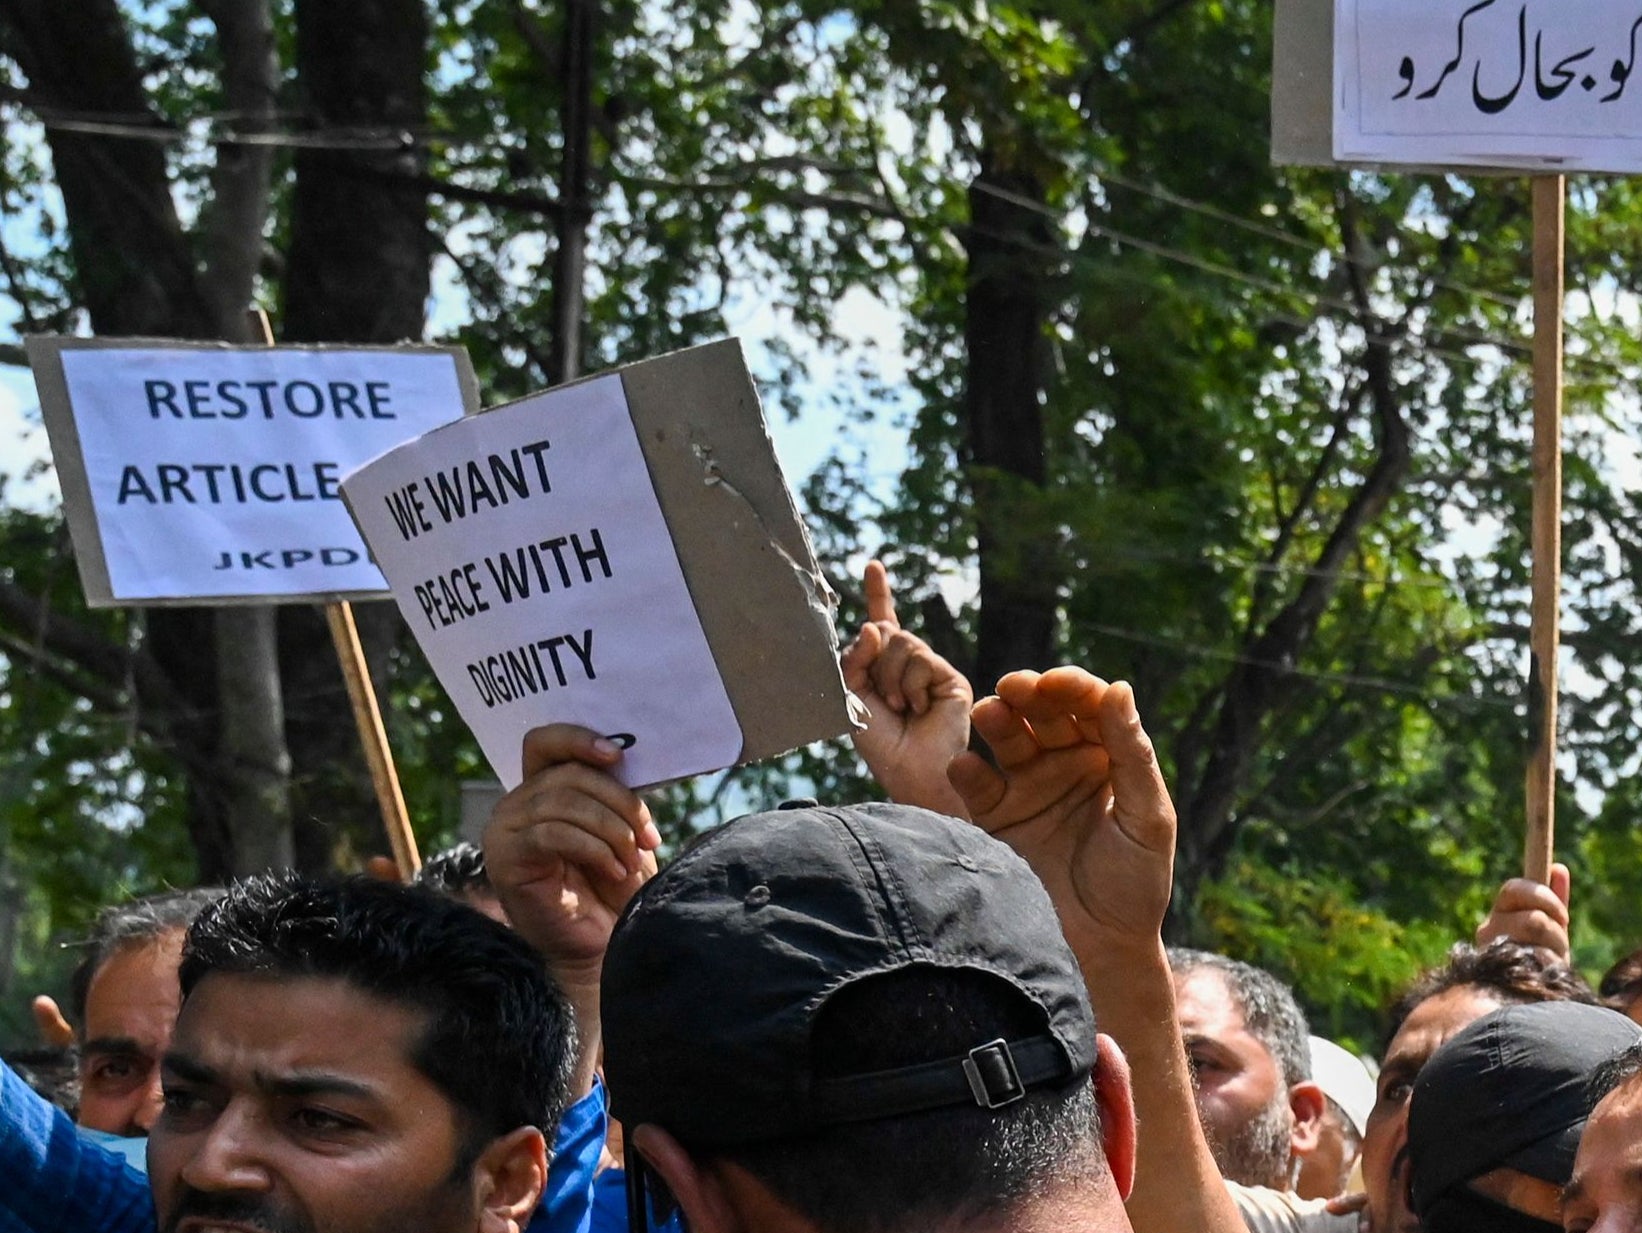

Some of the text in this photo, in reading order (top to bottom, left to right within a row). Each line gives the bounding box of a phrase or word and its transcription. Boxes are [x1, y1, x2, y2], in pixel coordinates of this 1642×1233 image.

[1391, 0, 1496, 101] کرو
[1473, 5, 1597, 115] بحال
[144, 379, 397, 420] RESTORE
[117, 463, 341, 505] ARTICLE
[385, 440, 552, 541] WE WANT
[213, 547, 374, 571] JKPD
[414, 528, 613, 630] PEACE WITH
[466, 629, 597, 708] DIGINITY
